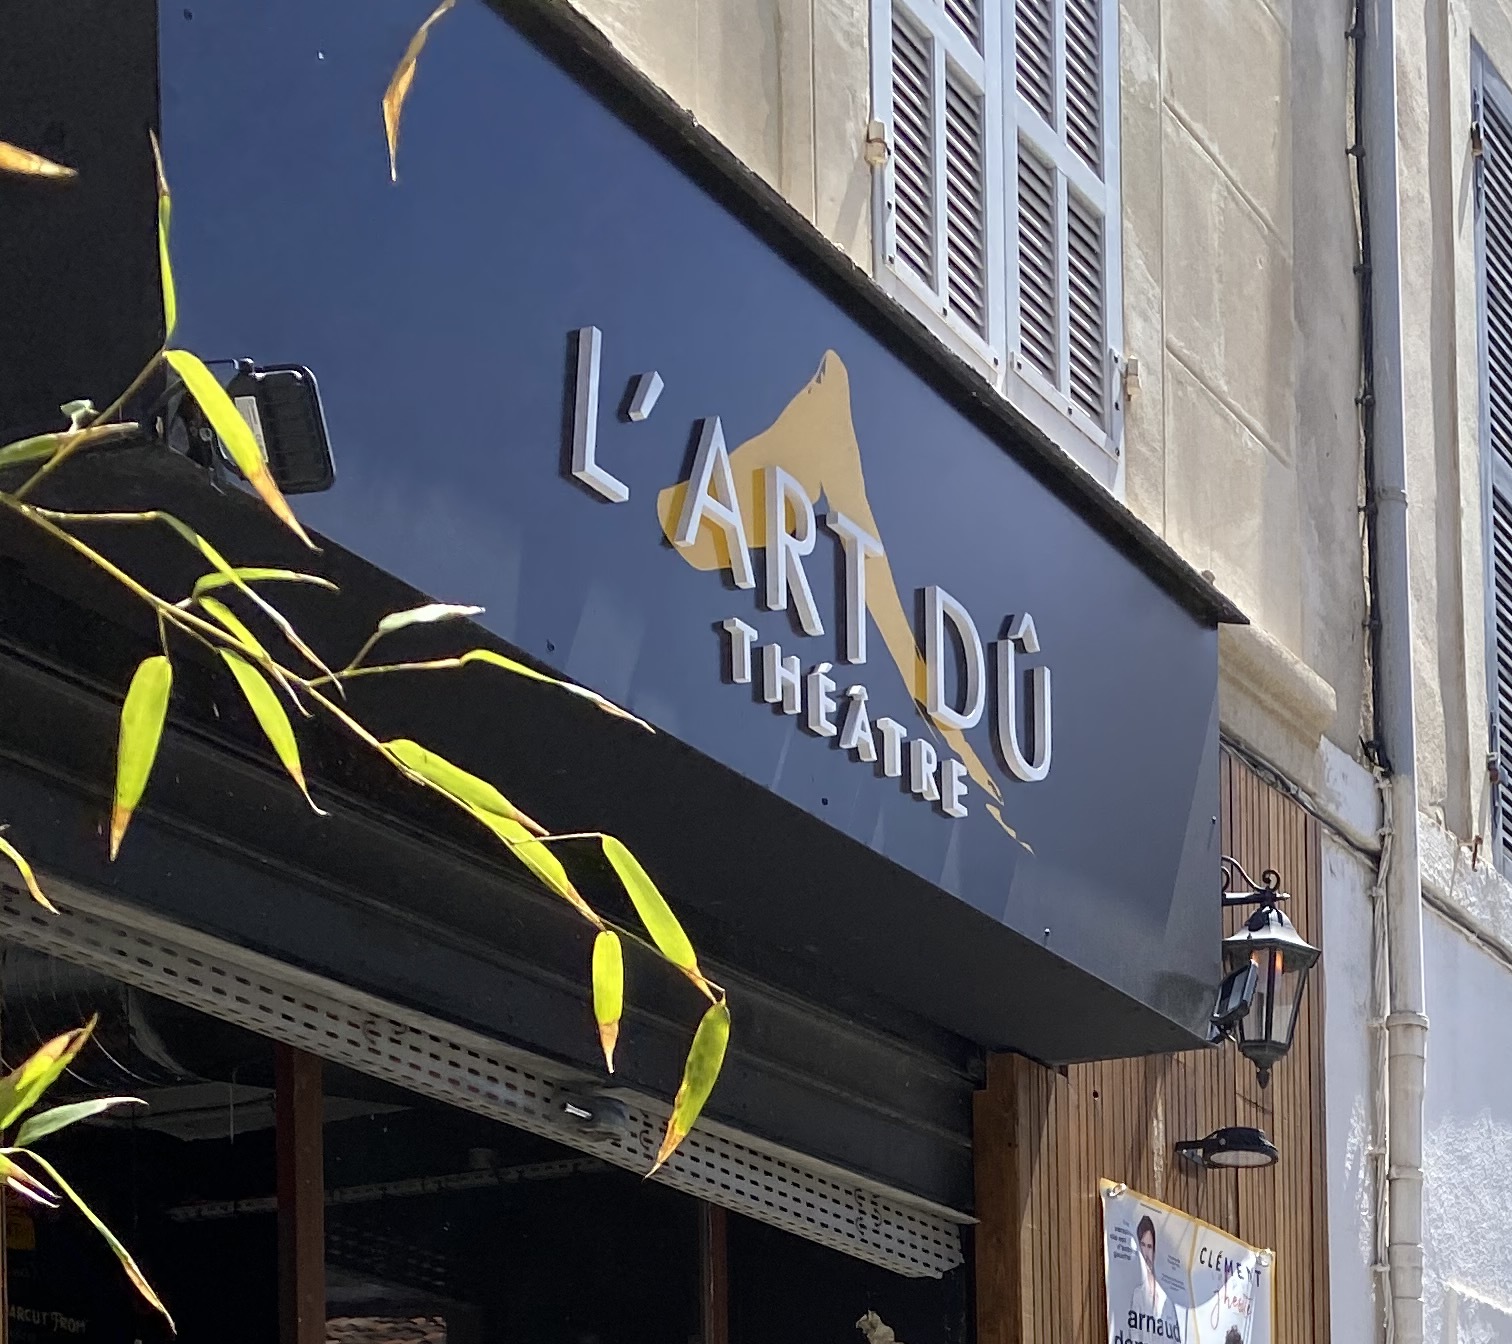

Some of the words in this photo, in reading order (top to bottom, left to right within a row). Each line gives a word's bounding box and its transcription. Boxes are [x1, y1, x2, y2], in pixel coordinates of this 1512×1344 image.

[570, 324, 884, 665] L'ART
[922, 584, 1052, 783] DÛ
[722, 617, 968, 818] THÉÂTRE
[1127, 1308, 1181, 1344] arnaud
